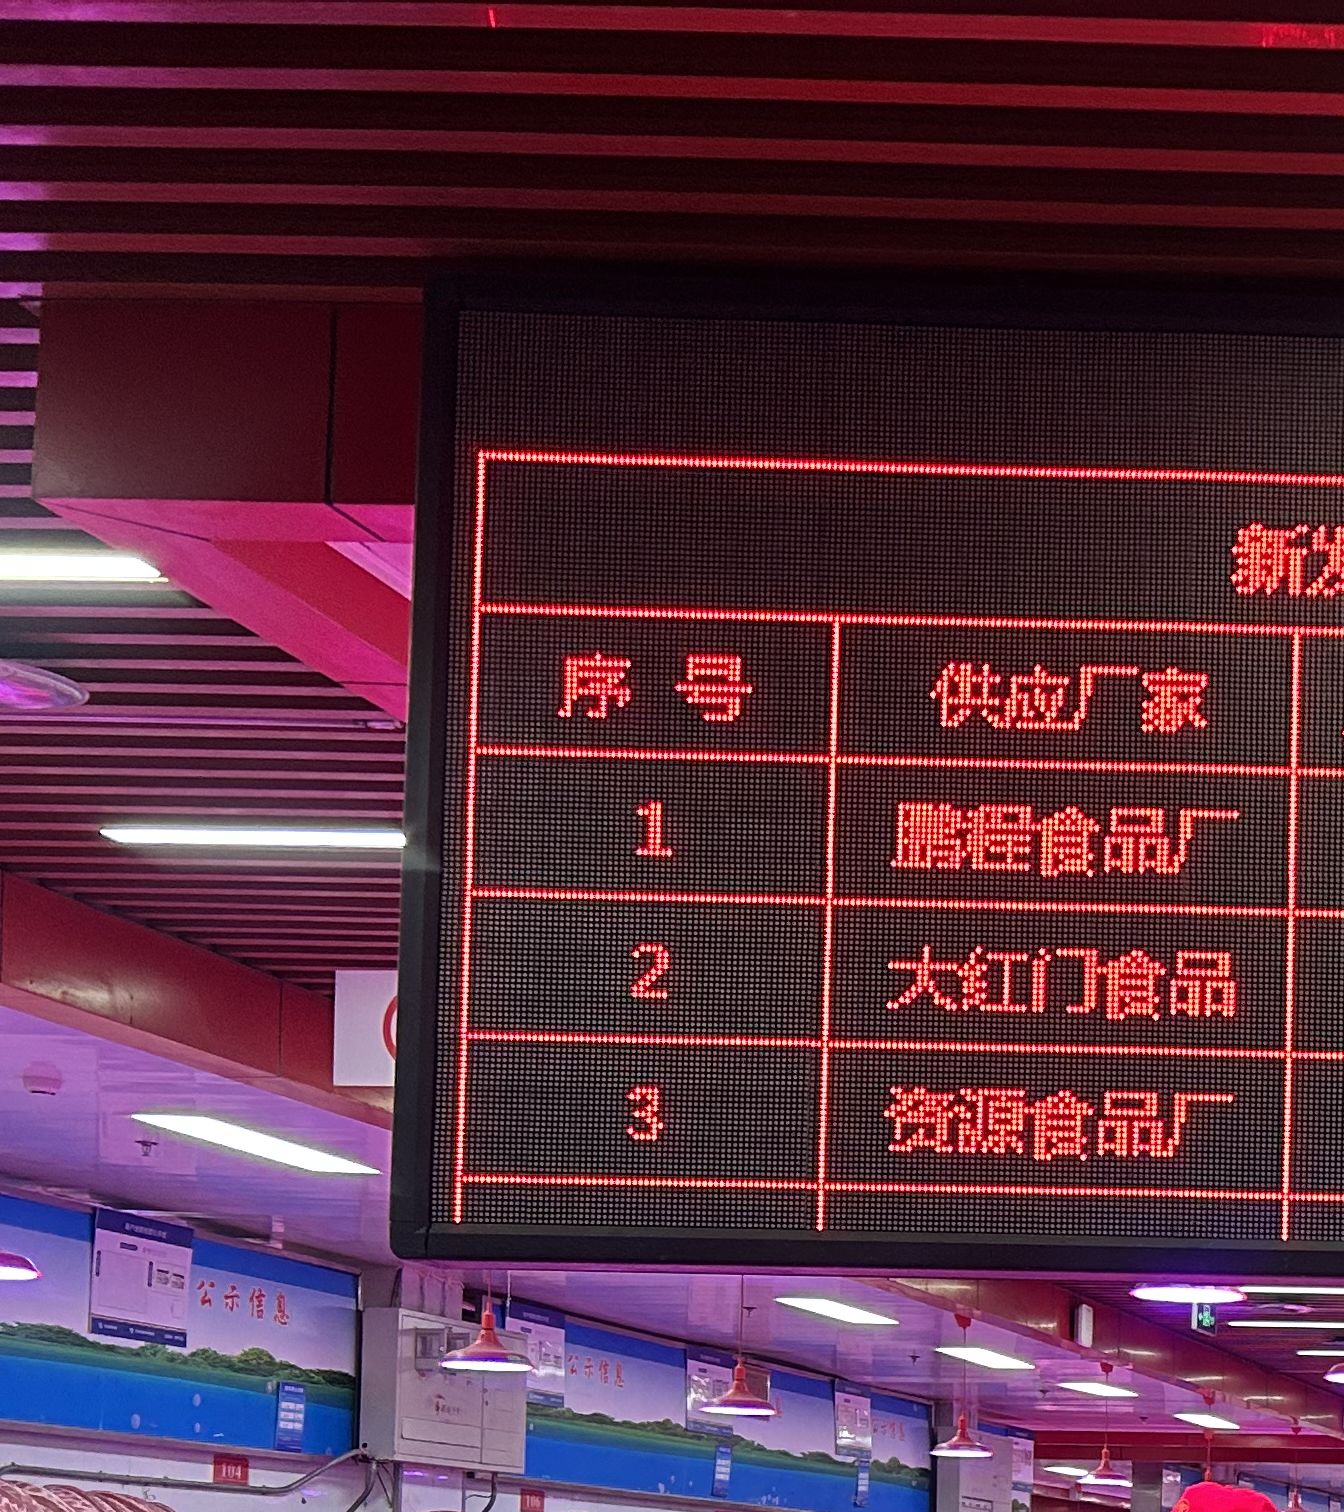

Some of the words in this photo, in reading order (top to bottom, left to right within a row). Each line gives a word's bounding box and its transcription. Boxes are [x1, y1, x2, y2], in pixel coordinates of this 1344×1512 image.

[930, 661, 1210, 735] 供应厂家
[635, 800, 672, 857] 1
[890, 801, 1241, 878] 鹏程食品厂
[630, 942, 672, 999] 2
[886, 944, 1238, 1021] 大红门食品
[626, 1086, 663, 1141] 3
[884, 1086, 1233, 1161] 资源食品厂
[196, 1279, 290, 1326] 公示信息
